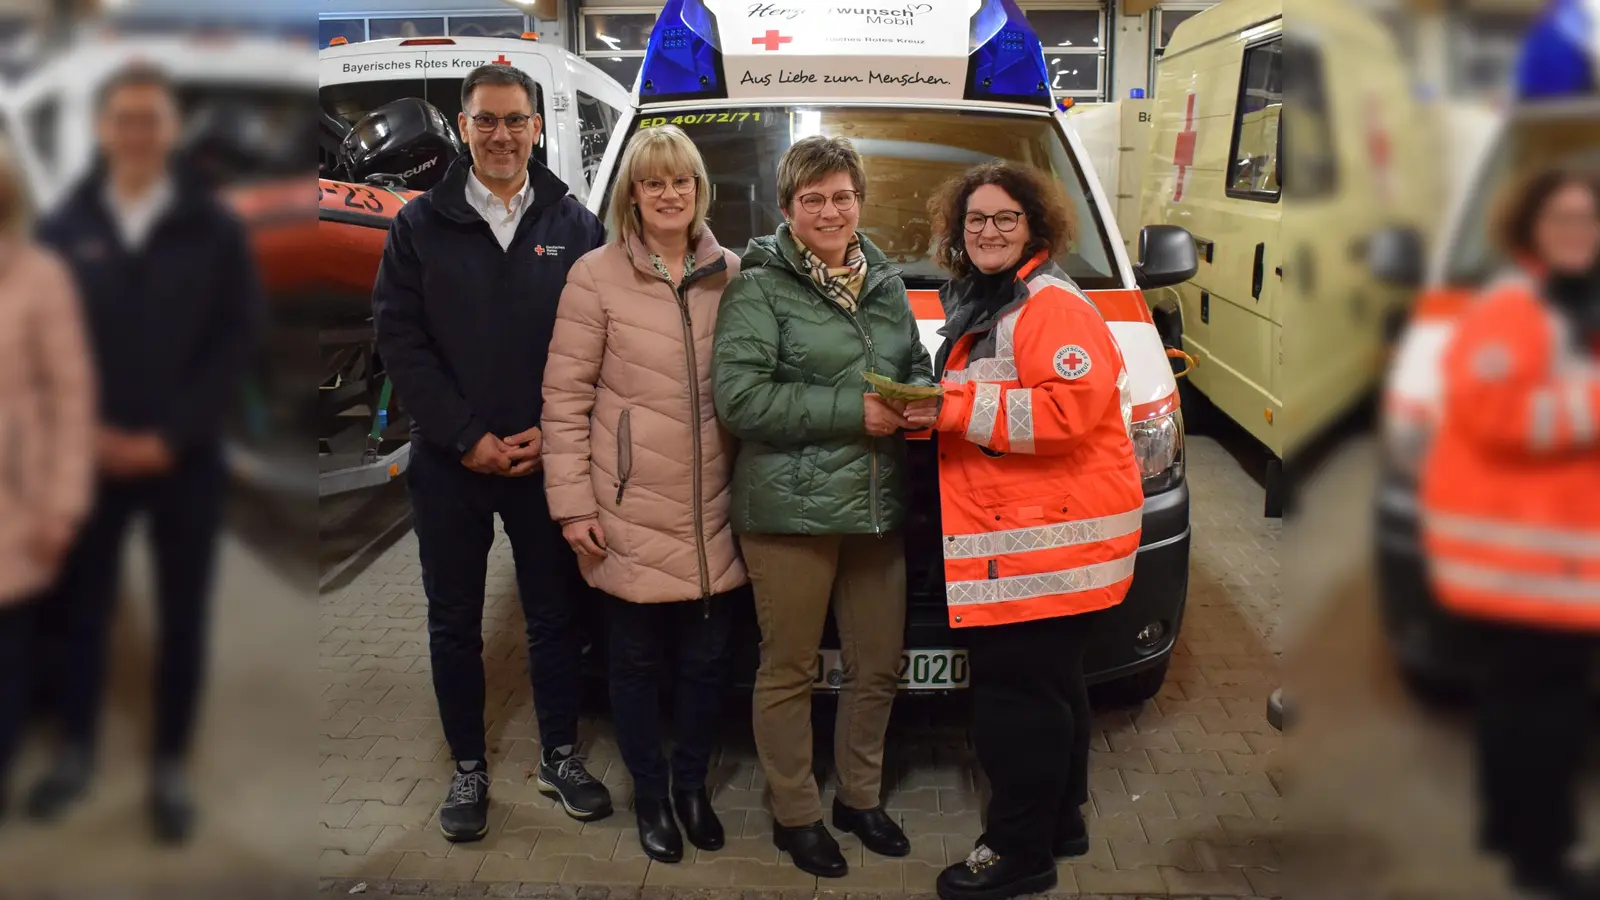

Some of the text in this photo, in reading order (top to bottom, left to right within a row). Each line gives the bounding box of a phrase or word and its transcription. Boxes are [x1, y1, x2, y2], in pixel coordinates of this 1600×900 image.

[866, 16, 914, 25] Mobil
[342, 58, 486, 74] Bayerisches Rotes Kreuz
[740, 70, 951, 86] Aus Liebe zum Menschen.
[639, 112, 761, 129] ED 40/72/71
[1057, 347, 1087, 359] DEUTSCHES
[1057, 362, 1088, 376] ROTES KREUZ
